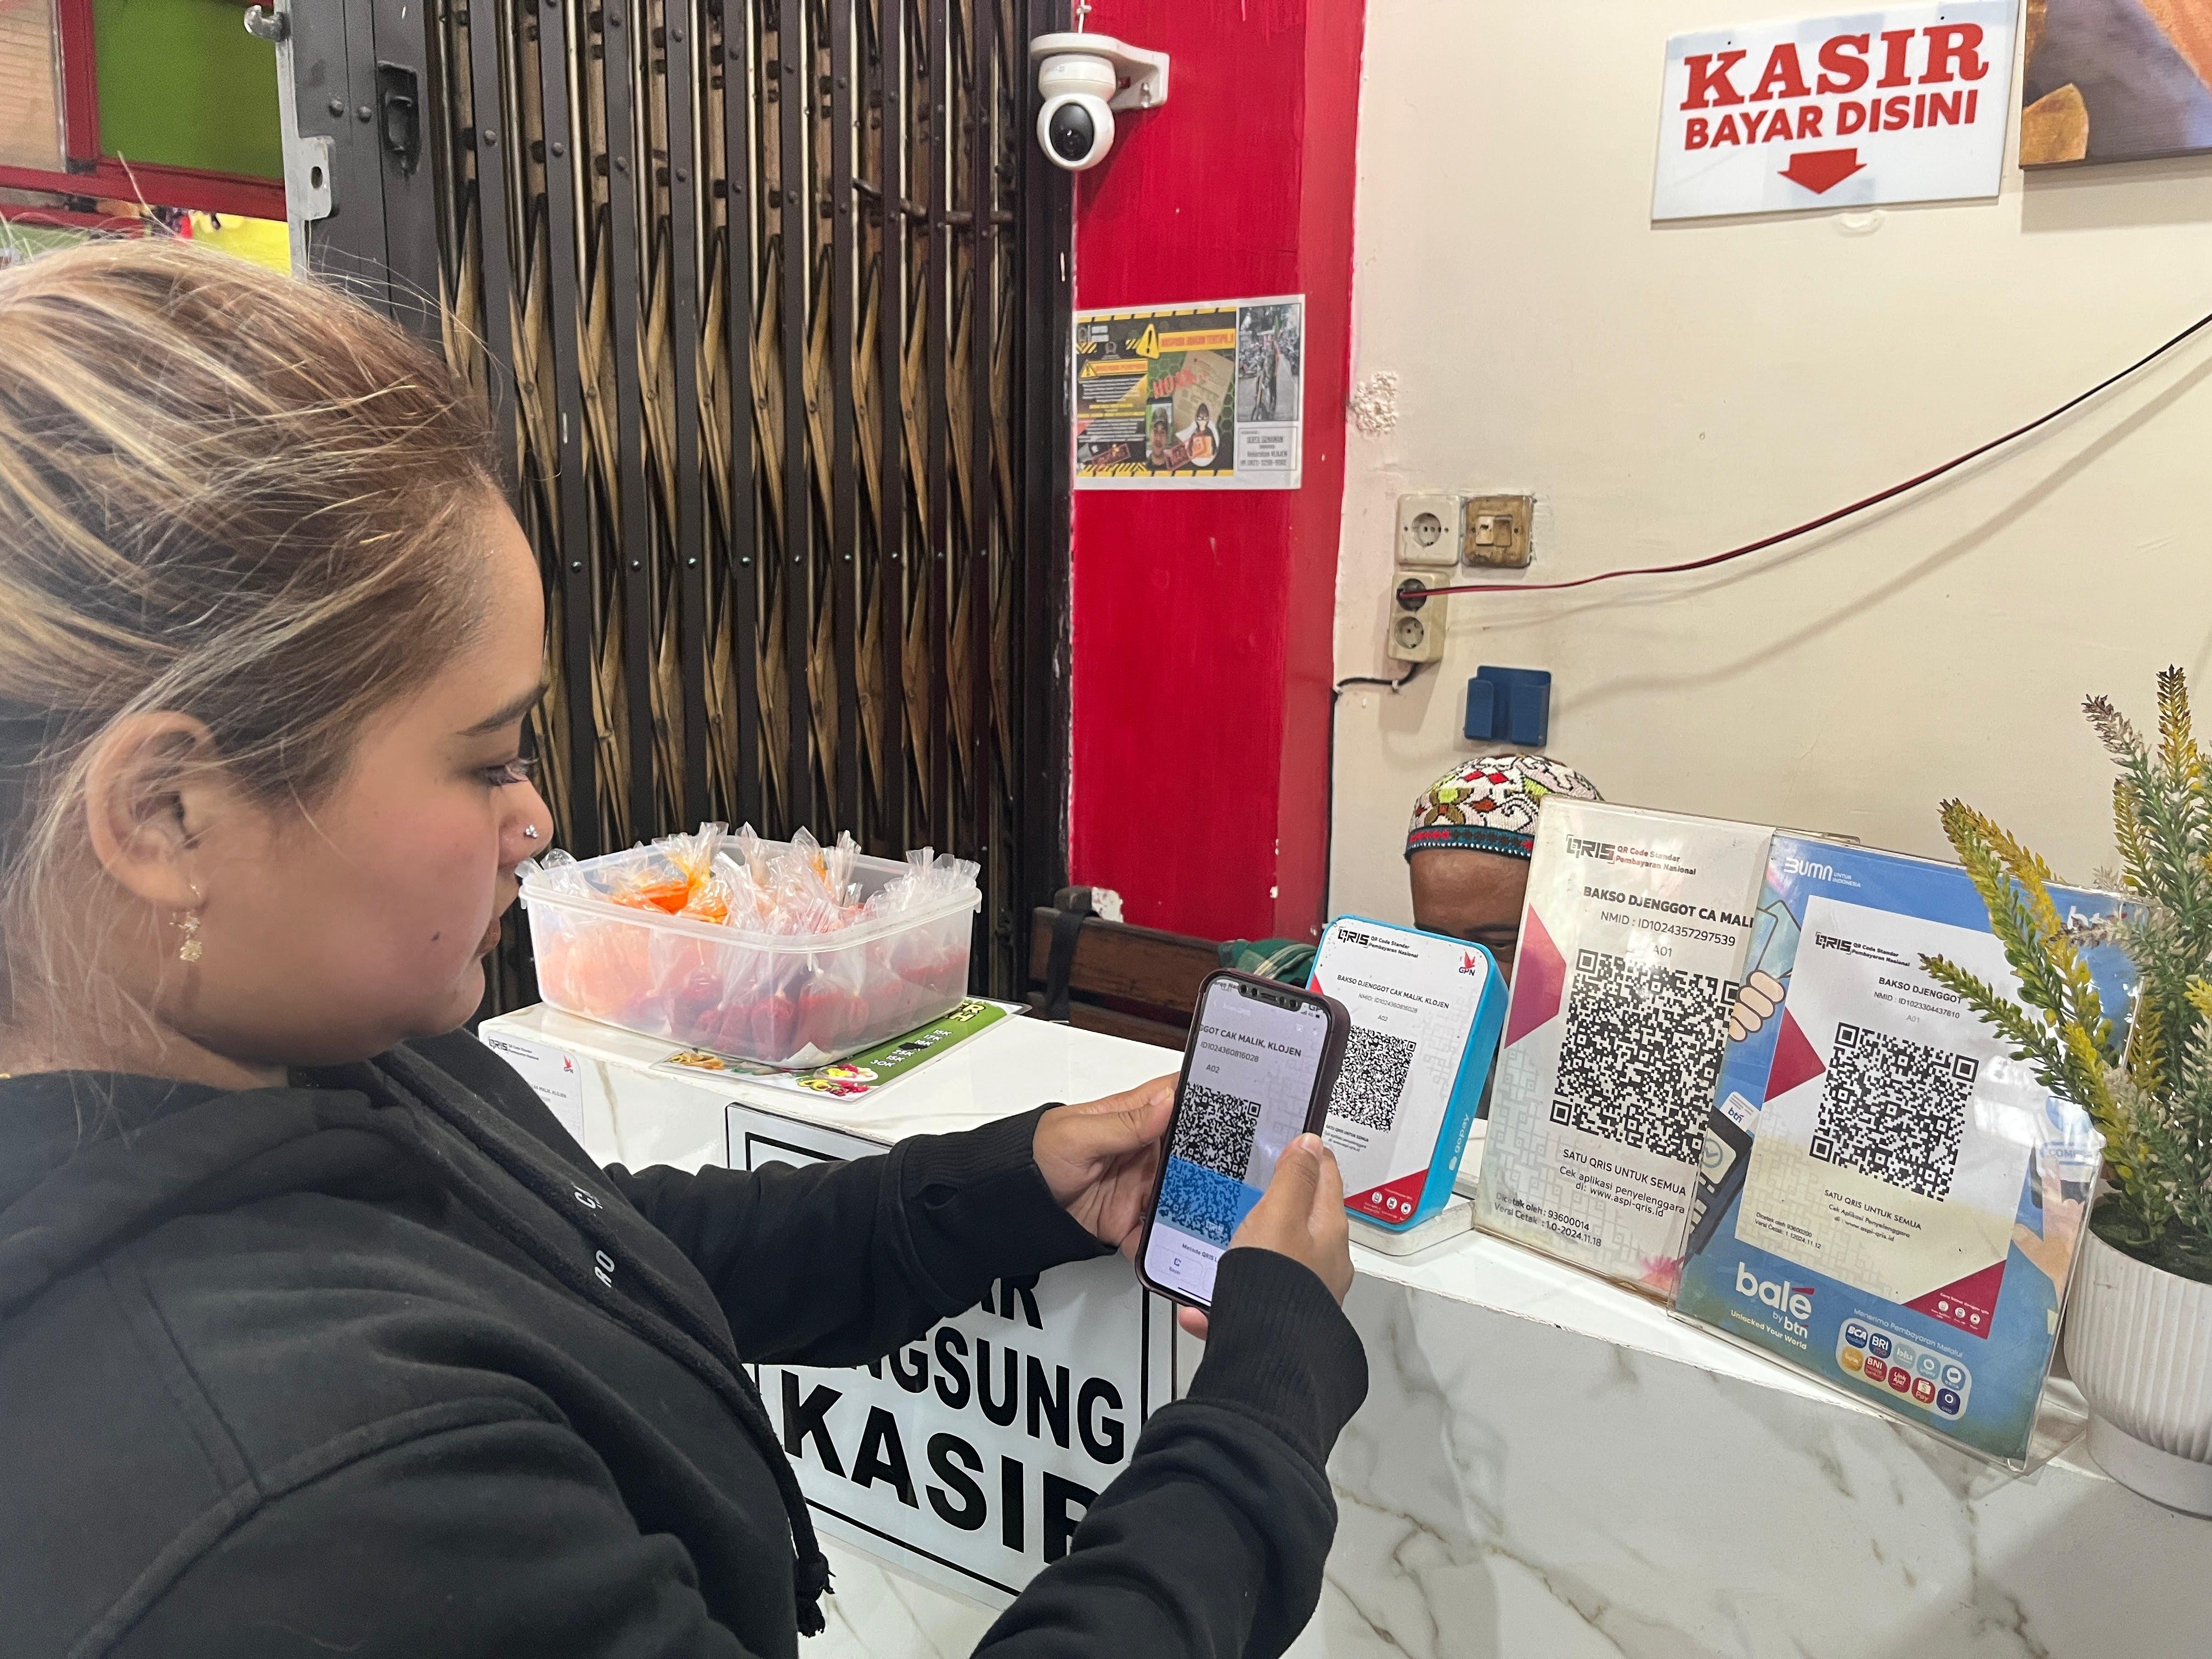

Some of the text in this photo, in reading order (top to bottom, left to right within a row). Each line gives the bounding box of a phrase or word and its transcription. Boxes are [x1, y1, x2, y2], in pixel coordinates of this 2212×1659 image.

[1680, 22, 1989, 111] KASIR
[1684, 89, 1978, 151] BAYAR DISINI
[1566, 834, 1616, 864] QRIS
[1630, 848, 1648, 856] Code
[1650, 851, 1680, 862] Standar
[1616, 856, 1696, 875] Pembayaran Nasional
[1583, 886, 1625, 904] BAKSO
[1628, 895, 1696, 918] DJENGGOT
[1699, 907, 1717, 922] CA
[1338, 927, 1370, 949] QRIS
[1600, 911, 1629, 925] NMID
[1638, 918, 1736, 946] ID1024357297539
[1369, 943, 1418, 958] Pembayaran Nasional
[1391, 941, 1409, 949] Standar
[1653, 945, 1672, 957] A01
[1815, 932, 1852, 955] QRIS
[1459, 967, 1475, 976] GPN
[1338, 975, 1357, 984] BAKSO
[1358, 980, 1389, 992] DJENGGOT
[1425, 998, 1449, 1009] KLOJEN
[1874, 992, 1893, 1001] NMID
[1879, 977, 1962, 1004] BAKSO DJENGGOT
[1906, 1015, 1920, 1023] A01
[1221, 1030, 1237, 1041] CAK
[1238, 1034, 1265, 1048] MALIK,
[1267, 1042, 1301, 1057] KLOJEN
[1206, 1064, 1220, 1074] A02
[1728, 1107, 1744, 1124] btn
[1454, 1113, 1469, 1154] gopay
[1563, 1149, 1686, 1196] SATU QRIS UNTUK SEMUA
[1560, 1166, 1685, 1214] Cek aplikasi penyelenggara
[1590, 1187, 1663, 1217] www.aspi-qris.id
[1495, 1203, 1513, 1215] Versi
[1515, 1210, 1537, 1224] Cetak
[1496, 1192, 1525, 1208] Dicetak
[1548, 1210, 1589, 1231] 93600014
[1824, 1190, 1922, 1230] SATU QRIS UNTUK SEMUA
[1829, 1204, 1910, 1238] Cek Aplikasi Penyelenggara
[1731, 1310, 1807, 1350] Unlocked Your World
[1773, 1311, 1809, 1339] by btn
[1847, 1326, 1867, 1340] BCA
[1854, 1308, 1889, 1328] Menerima
[1890, 1323, 1936, 1347] Pembayaran
[1872, 1336, 1889, 1351] BRI
[1897, 1348, 1913, 1361] blu
[1867, 1357, 1883, 1369] BNI
[852, 1327, 1124, 1465] GSUNG
[1916, 1391, 1928, 1402] Pay
